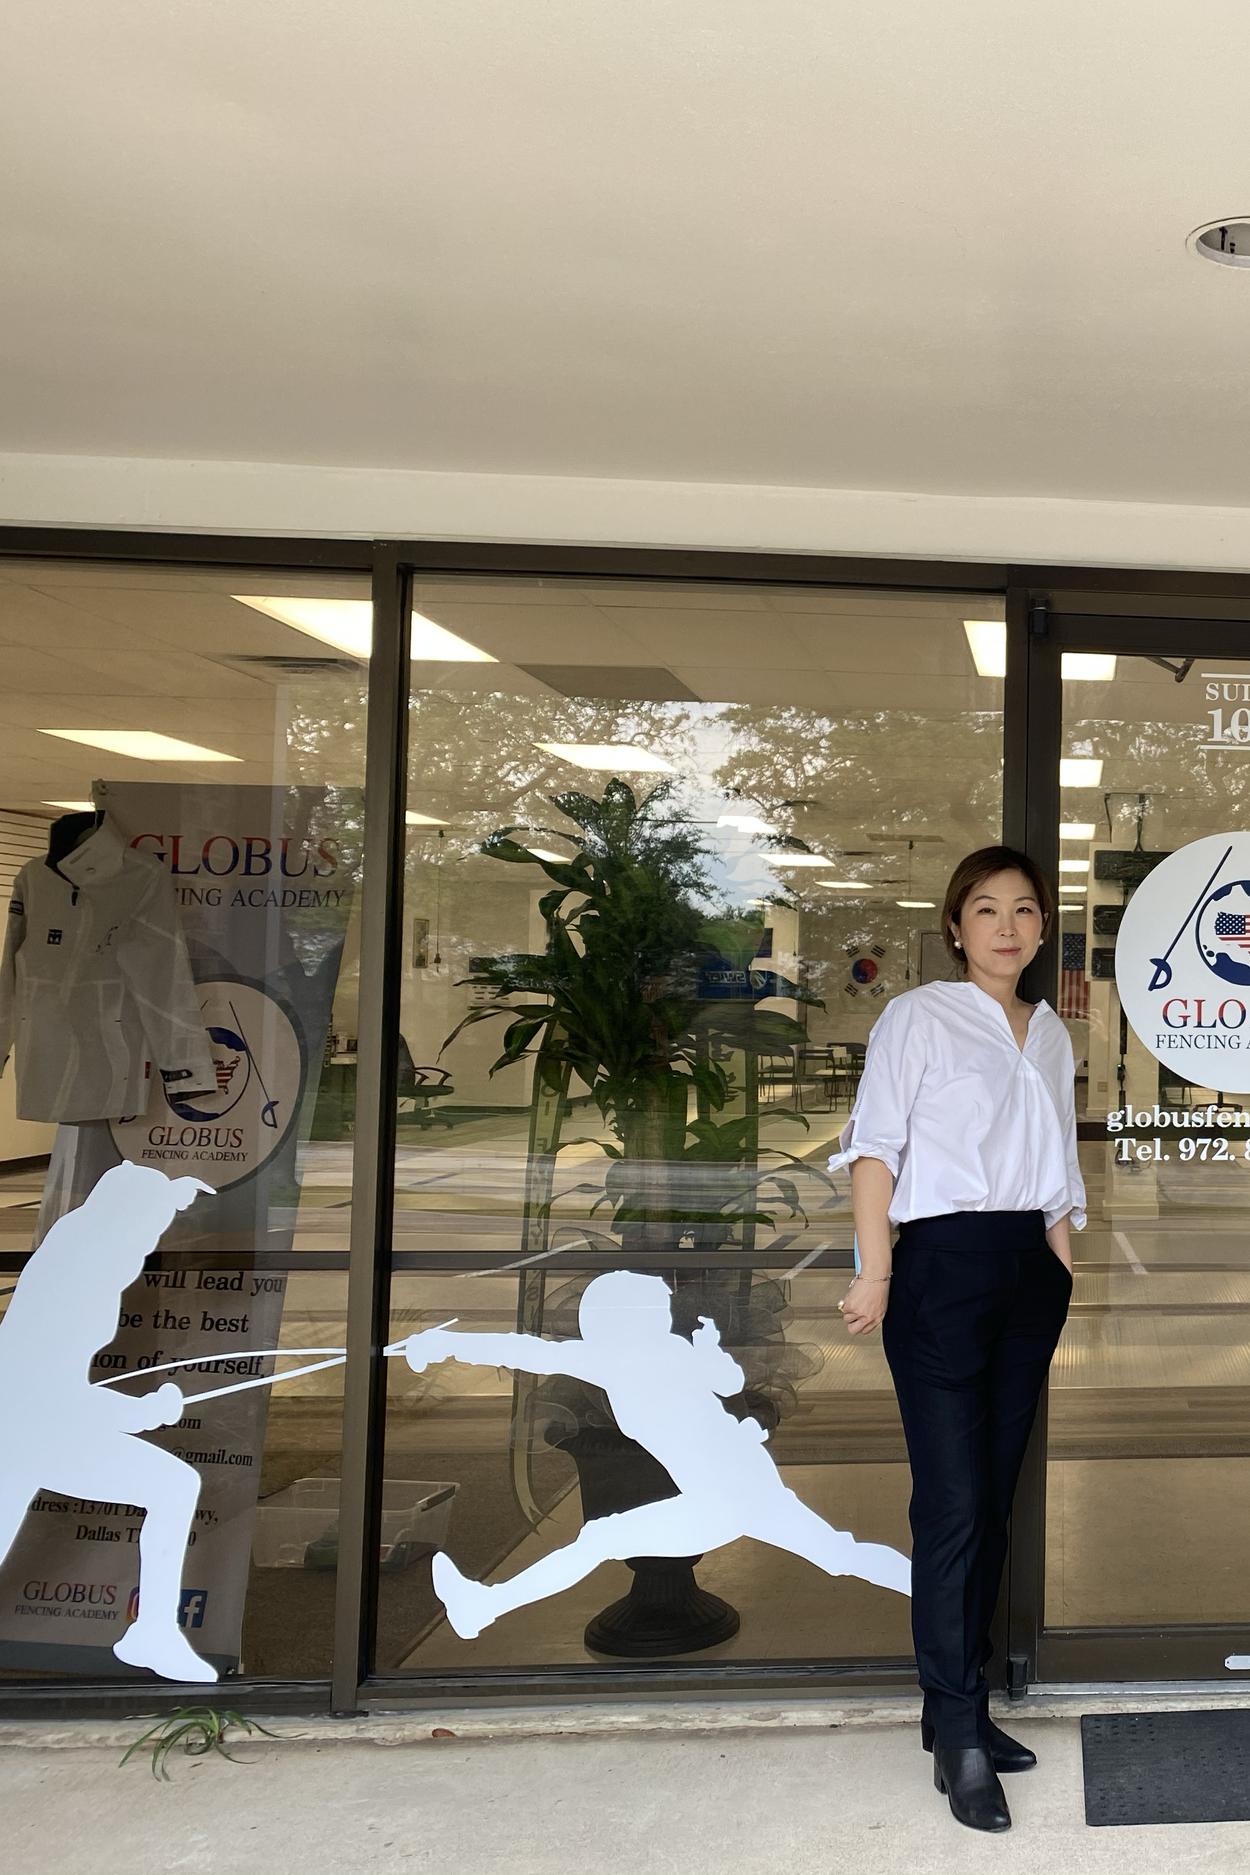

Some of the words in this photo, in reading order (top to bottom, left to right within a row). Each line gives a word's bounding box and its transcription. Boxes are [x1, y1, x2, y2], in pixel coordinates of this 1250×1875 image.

[230, 889, 346, 908] ACADEMY
[1155, 1033, 1241, 1050] FENCING
[148, 1125, 244, 1149] GLOBUS
[141, 1149, 189, 1160] FENCING
[191, 1151, 249, 1162] ACADEMY
[1114, 1137, 1171, 1162] Tel.
[1178, 1137, 1236, 1162] 972.
[143, 1270, 186, 1289] will
[195, 1270, 244, 1291] lead
[250, 1278, 283, 1297] you
[152, 1308, 191, 1331] the
[200, 1311, 249, 1333] best
[136, 1351, 163, 1370] of
[76, 1524, 121, 1542] Dallas
[23, 1580, 118, 1605] GLOBUS
[14, 1604, 62, 1617] FENCING
[64, 1608, 120, 1621] ACADEMY
